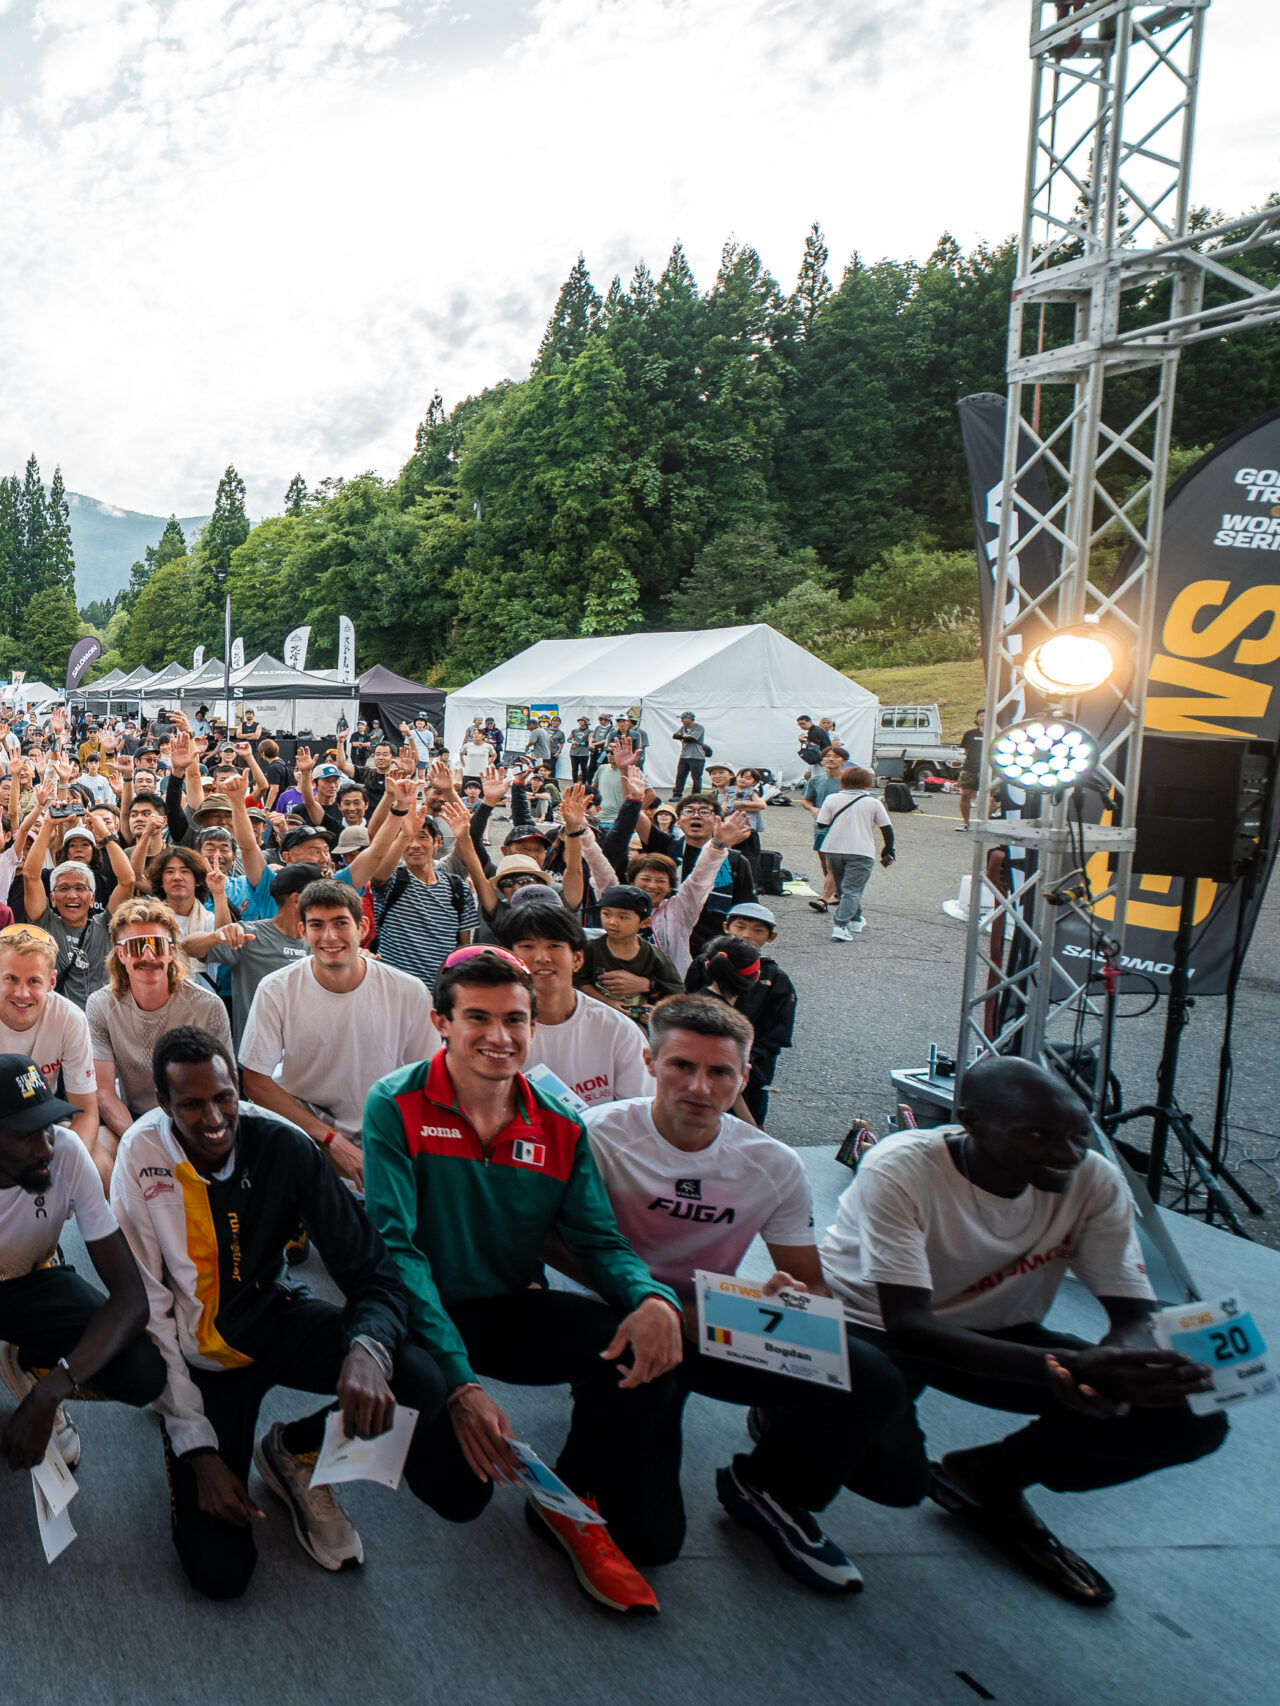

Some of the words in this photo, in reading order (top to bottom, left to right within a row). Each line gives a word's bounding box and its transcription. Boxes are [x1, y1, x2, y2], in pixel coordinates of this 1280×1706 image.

[72, 644, 98, 679] SALOMON
[283, 947, 307, 956] GTWS
[647, 1197, 736, 1225] FUGA
[720, 1281, 762, 1299] GTWS
[758, 1307, 784, 1333] 7
[764, 1342, 812, 1362] Bogdan
[1209, 1326, 1251, 1361] 20
